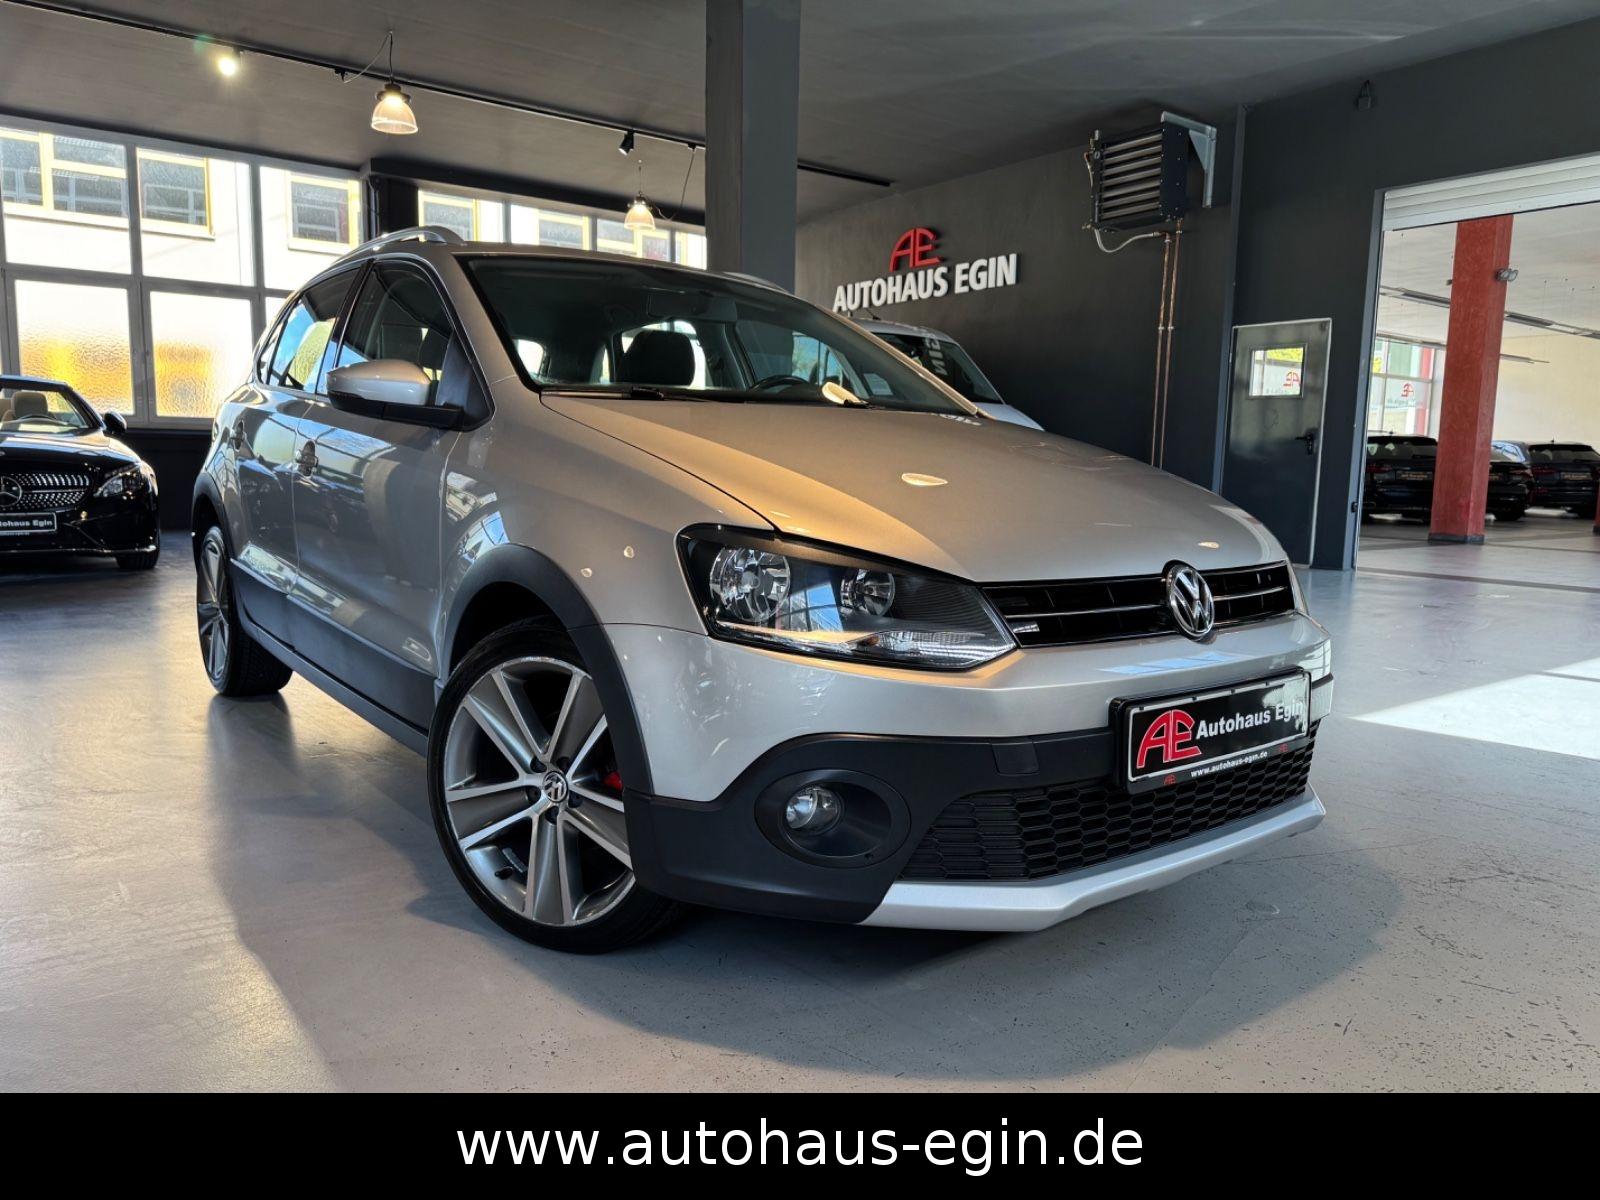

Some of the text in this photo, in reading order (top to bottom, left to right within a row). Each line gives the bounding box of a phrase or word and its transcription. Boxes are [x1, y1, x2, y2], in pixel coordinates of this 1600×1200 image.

[832, 253, 1017, 313] AUTOHAUS EGIN
[1195, 697, 1305, 740] Autohaus Egin
[1190, 751, 1268, 779] www.autohaus-egin.de
